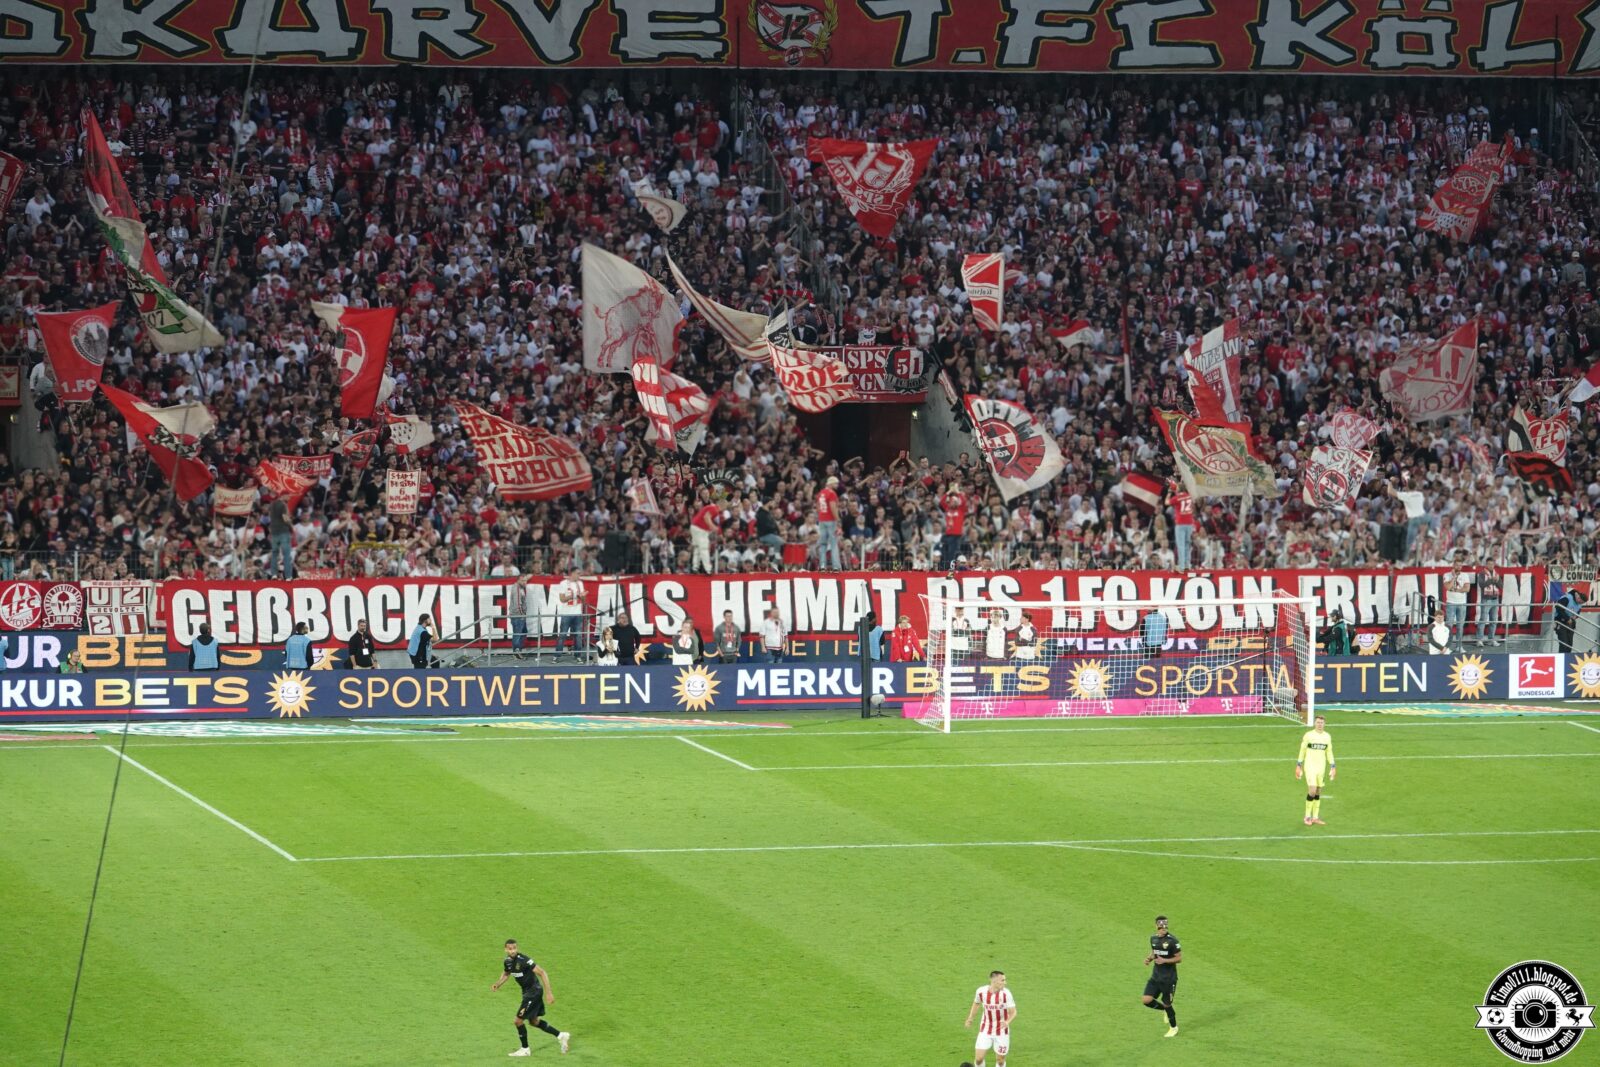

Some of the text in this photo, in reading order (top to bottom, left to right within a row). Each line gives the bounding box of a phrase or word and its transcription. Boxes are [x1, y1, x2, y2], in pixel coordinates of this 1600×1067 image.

[782, 14, 810, 39] 12
[847, 350, 887, 369] SPS
[897, 357, 921, 375] 51
[60, 378, 98, 393] 1.FC
[1180, 500, 1192, 512] 12
[172, 583, 570, 645] GEIßBOCKHEM
[595, 580, 686, 636] ALS
[711, 577, 903, 634] HEIMAT
[927, 575, 1022, 631] DES
[1041, 575, 1137, 631] 1.FC
[1150, 573, 1275, 630] KÖLN
[2, 661, 1427, 709] KUR BETS SPORTWETTEN MERKUR BETS SPORTWETTEN
